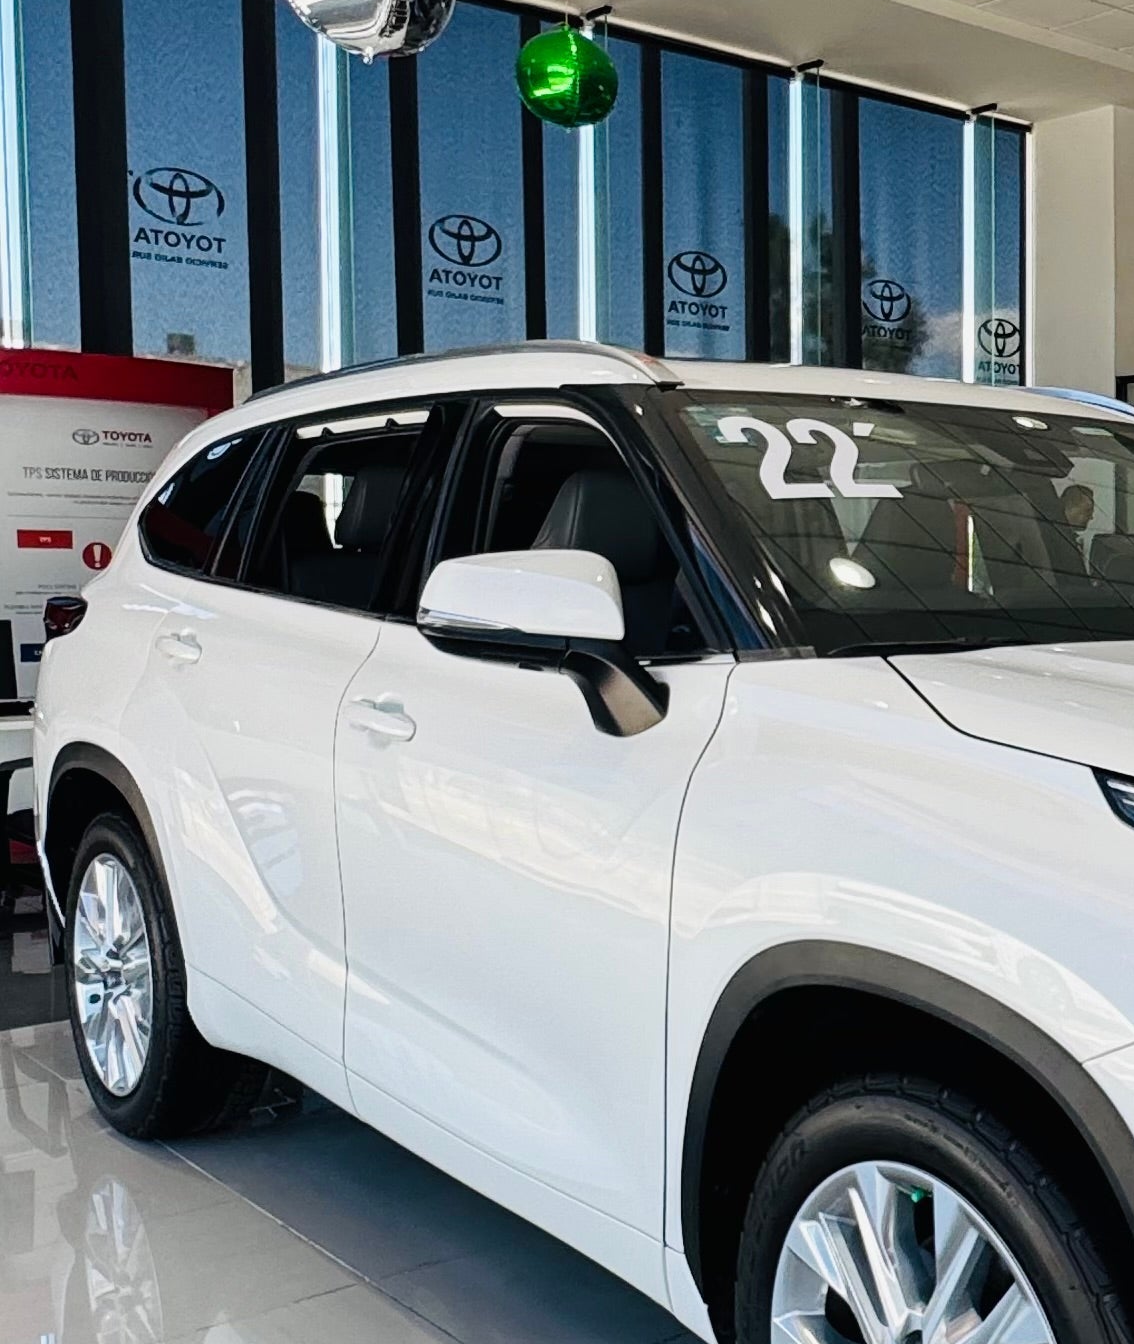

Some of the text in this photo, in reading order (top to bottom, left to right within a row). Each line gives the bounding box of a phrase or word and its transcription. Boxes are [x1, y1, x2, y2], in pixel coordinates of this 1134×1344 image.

[101, 430, 153, 443] TOYOTA
[22, 466, 43, 480] TPS
[45, 467, 89, 481] SISTEMA
[91, 468, 103, 482] DE
